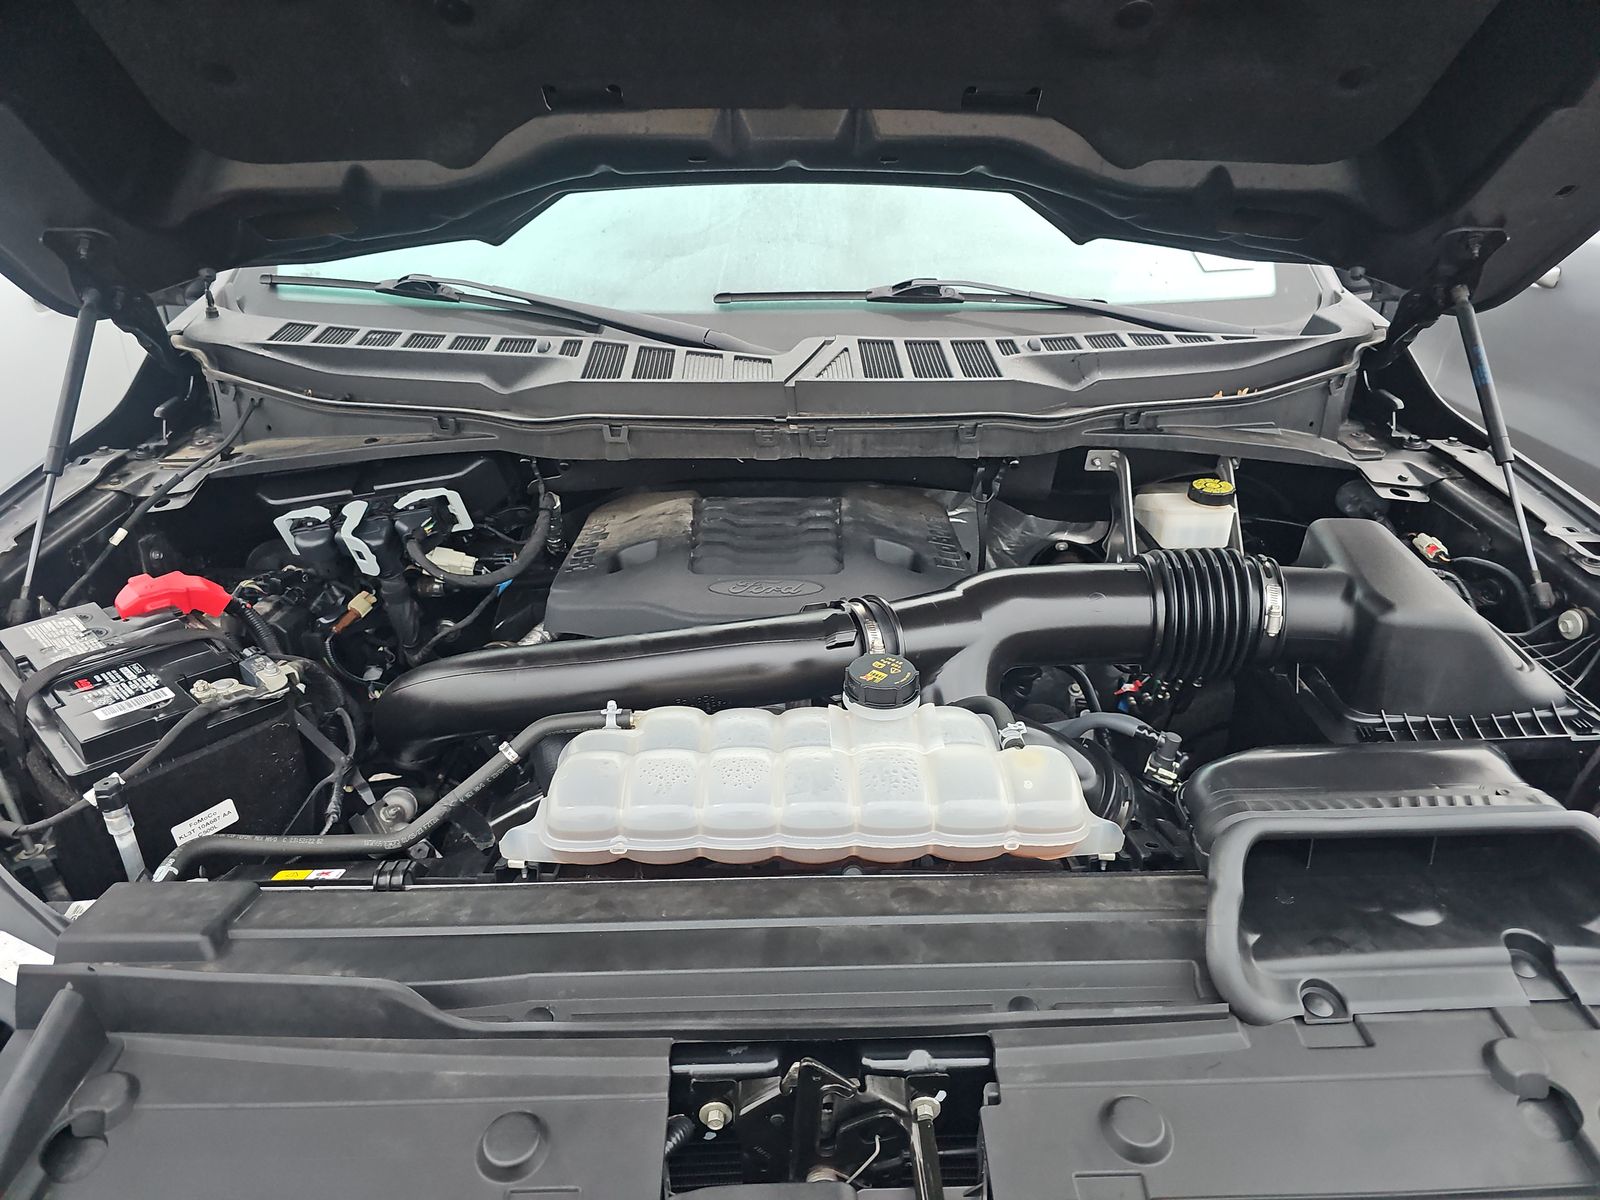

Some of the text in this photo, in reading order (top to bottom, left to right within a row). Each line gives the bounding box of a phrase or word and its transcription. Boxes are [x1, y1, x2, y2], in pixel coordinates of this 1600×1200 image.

[728, 580, 804, 594] Ford
[178, 810, 232, 841] KL3T 10A687 AA
[188, 811, 217, 828] FoMoCo
